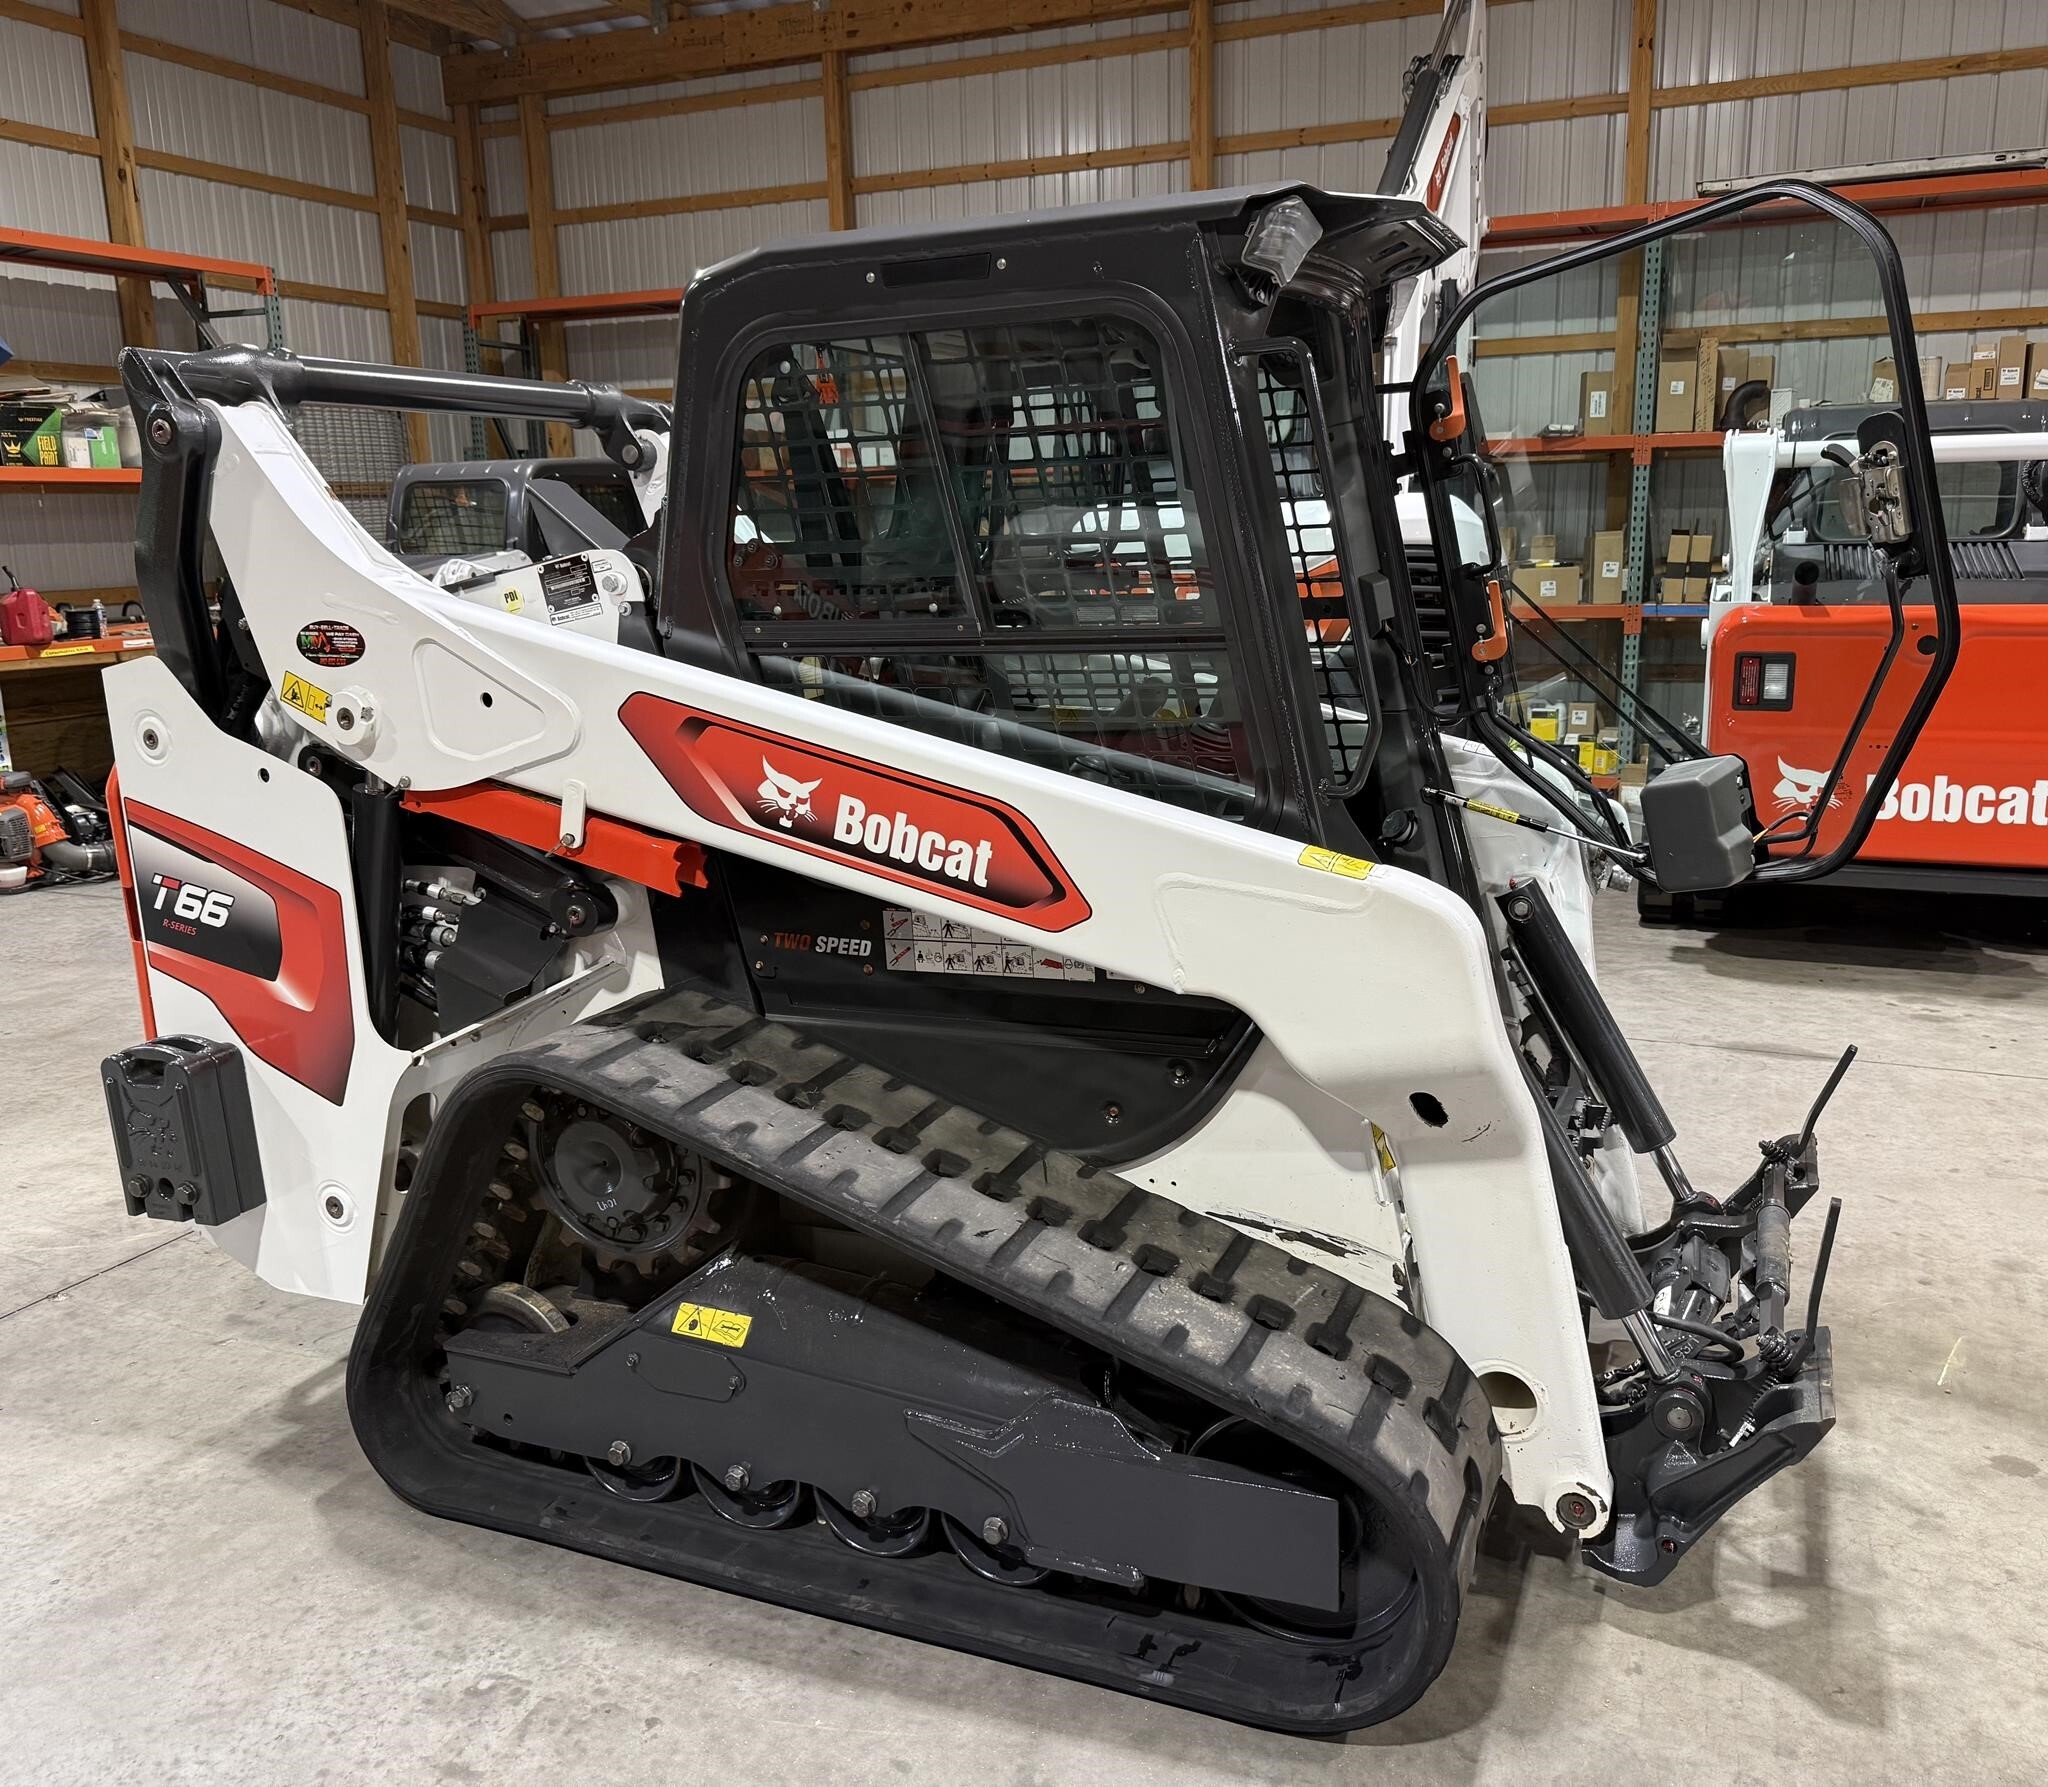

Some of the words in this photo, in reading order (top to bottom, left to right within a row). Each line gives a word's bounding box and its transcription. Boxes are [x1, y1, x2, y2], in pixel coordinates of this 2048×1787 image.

[37, 435, 57, 451] FIELD
[39, 451, 58, 465] PAINT
[504, 589, 519, 604] PDI
[833, 794, 993, 888] Bobcat
[152, 873, 235, 928] T66
[163, 919, 197, 936] R-SERIES
[774, 932, 811, 950] TWO
[815, 936, 872, 957] SPEED
